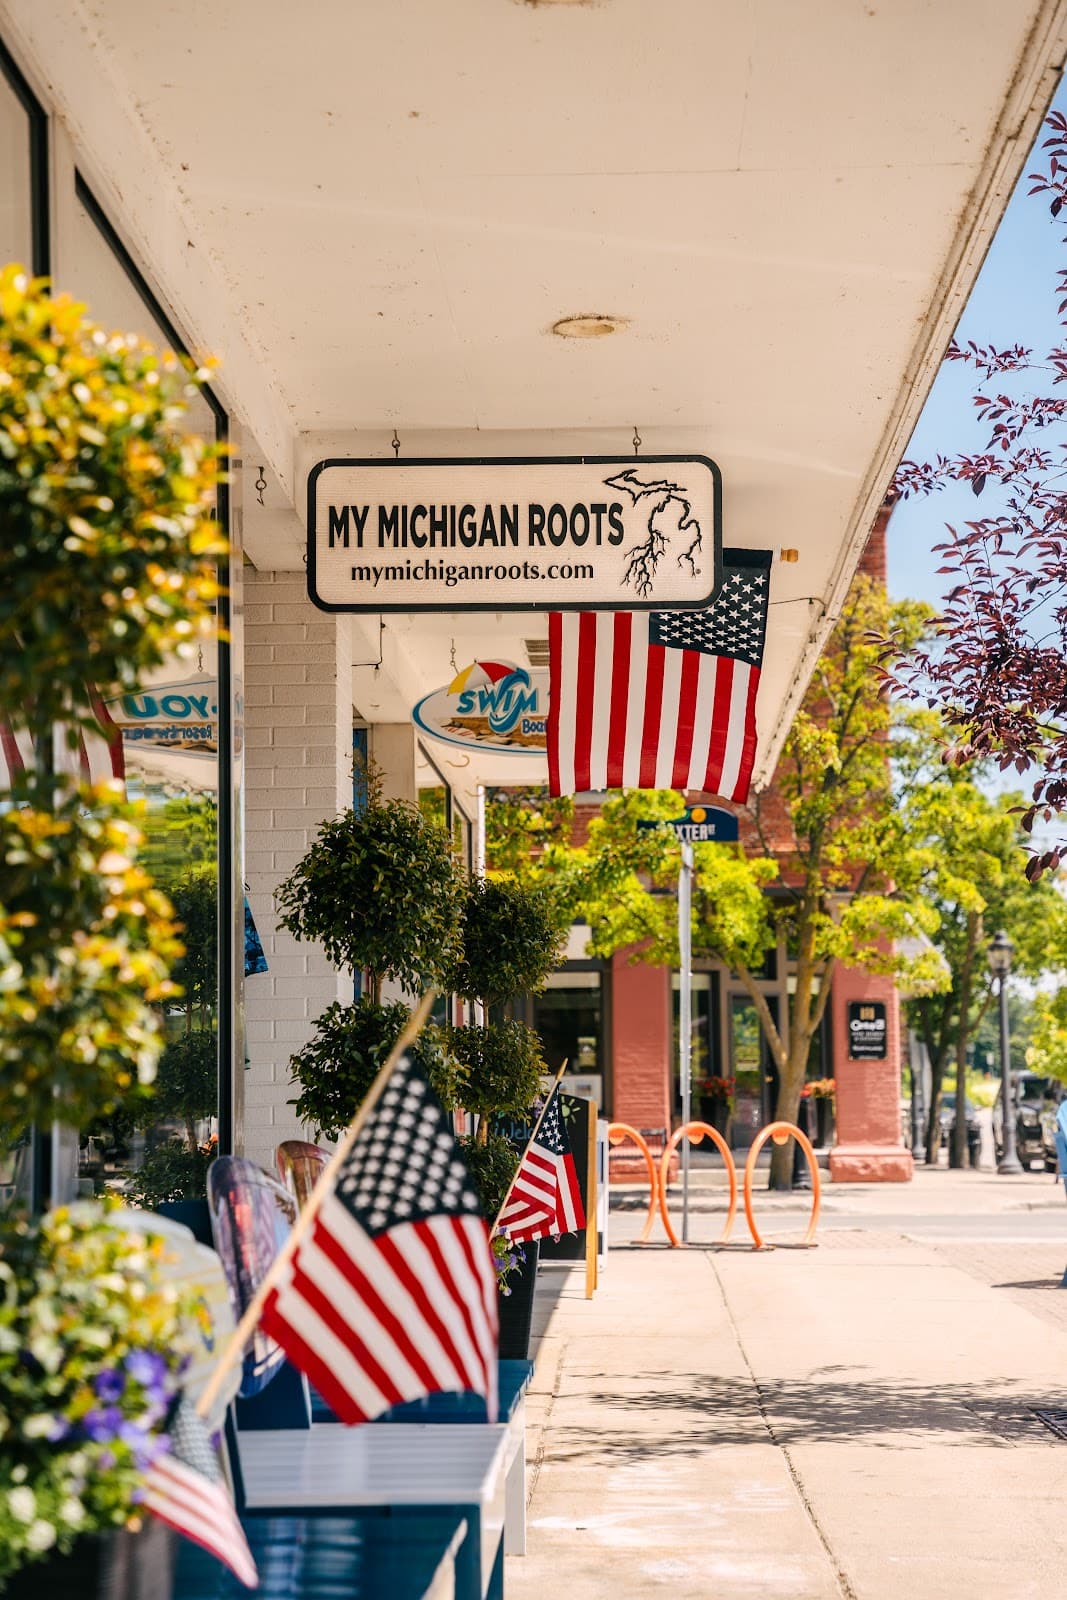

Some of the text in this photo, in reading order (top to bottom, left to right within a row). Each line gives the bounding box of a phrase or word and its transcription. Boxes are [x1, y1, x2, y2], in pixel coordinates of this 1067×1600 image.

[328, 502, 625, 548] MY MICHIGAN ROOTS
[351, 559, 595, 587] mymichiganroots.com
